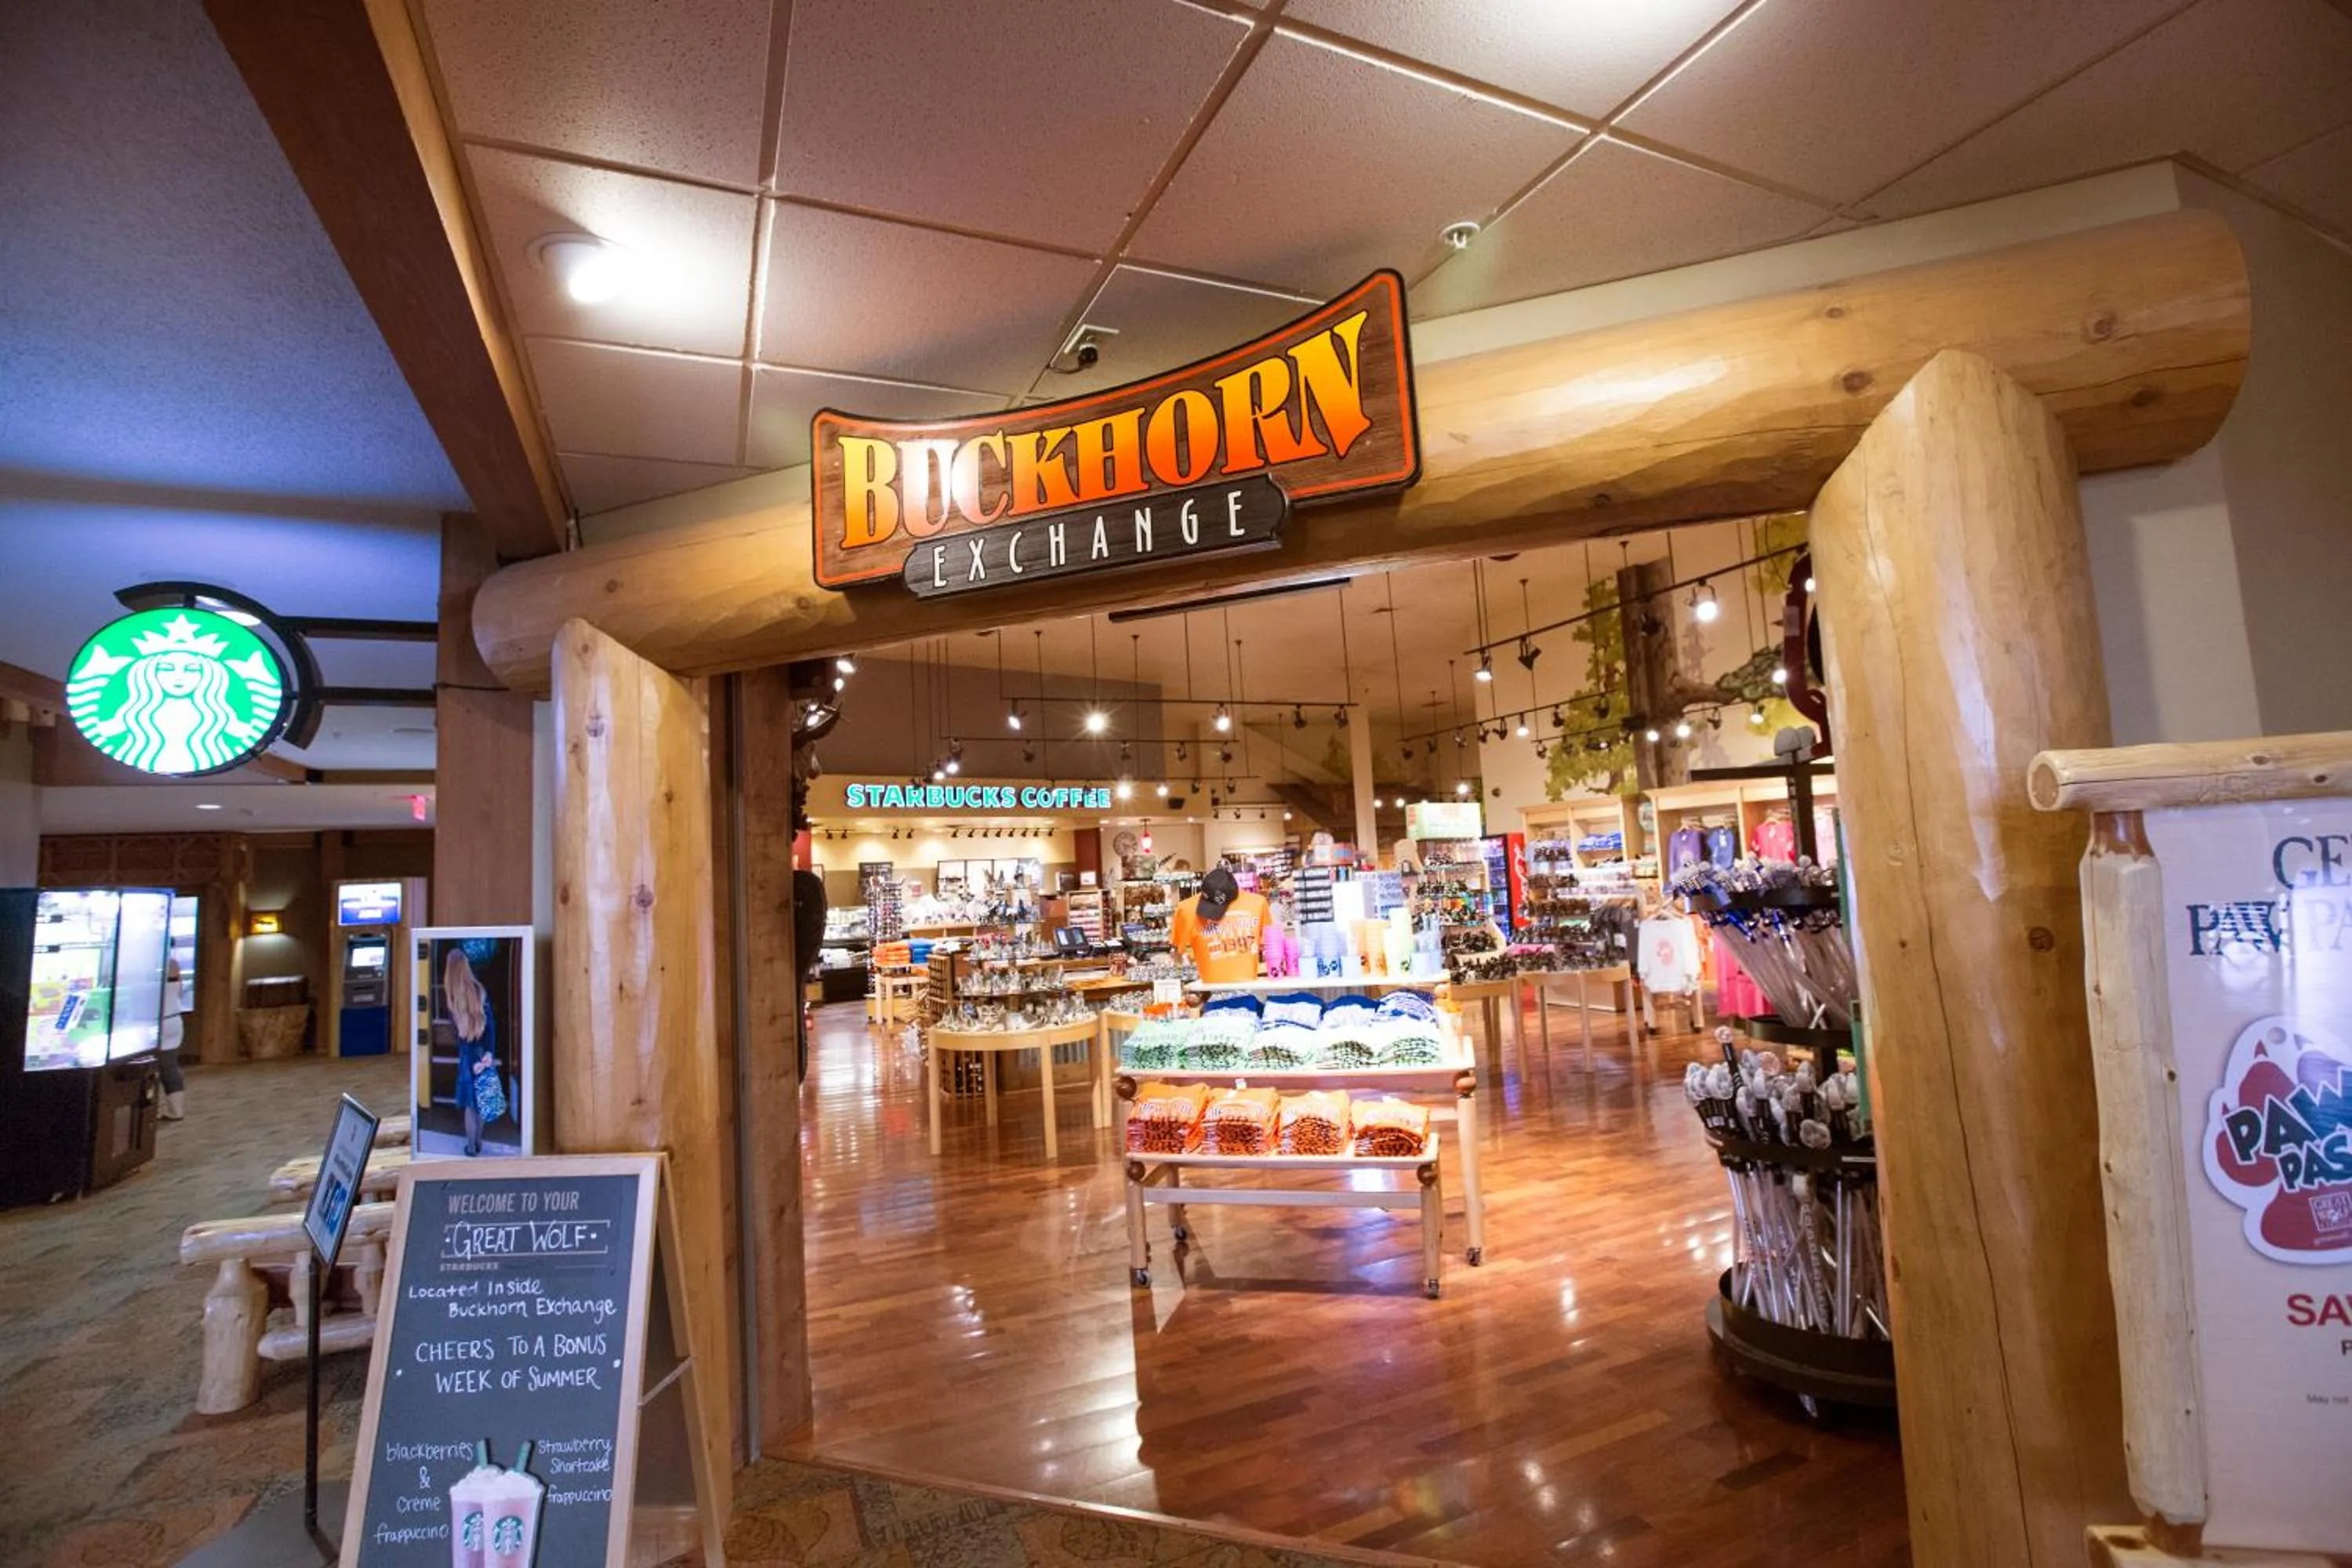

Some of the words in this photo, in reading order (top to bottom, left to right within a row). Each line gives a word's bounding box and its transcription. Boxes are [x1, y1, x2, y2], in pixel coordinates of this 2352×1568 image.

[838, 309, 1372, 550] BUCKHORN
[932, 489, 1245, 588] EXCHANGE
[846, 783, 1017, 809] STARBUCKS
[1020, 786, 1111, 809] COFFEE
[448, 1192, 516, 1214] WELCOME
[521, 1192, 538, 1212] TO
[543, 1191, 579, 1210] YOUR
[452, 1220, 521, 1260] GREAT
[529, 1220, 588, 1253] WOLF
[408, 1280, 478, 1299] Located
[488, 1277, 543, 1296] Inside
[448, 1301, 528, 1319] Buckhorn
[535, 1295, 617, 1324] Exchange
[416, 1338, 495, 1362] CHEERS
[532, 1334, 546, 1357] A
[554, 1333, 608, 1357] BONUS
[435, 1368, 493, 1393] WEEK
[501, 1369, 523, 1389] OF
[528, 1365, 602, 1392] SUMMER
[386, 1441, 474, 1463] blackberries
[419, 1465, 431, 1489] &
